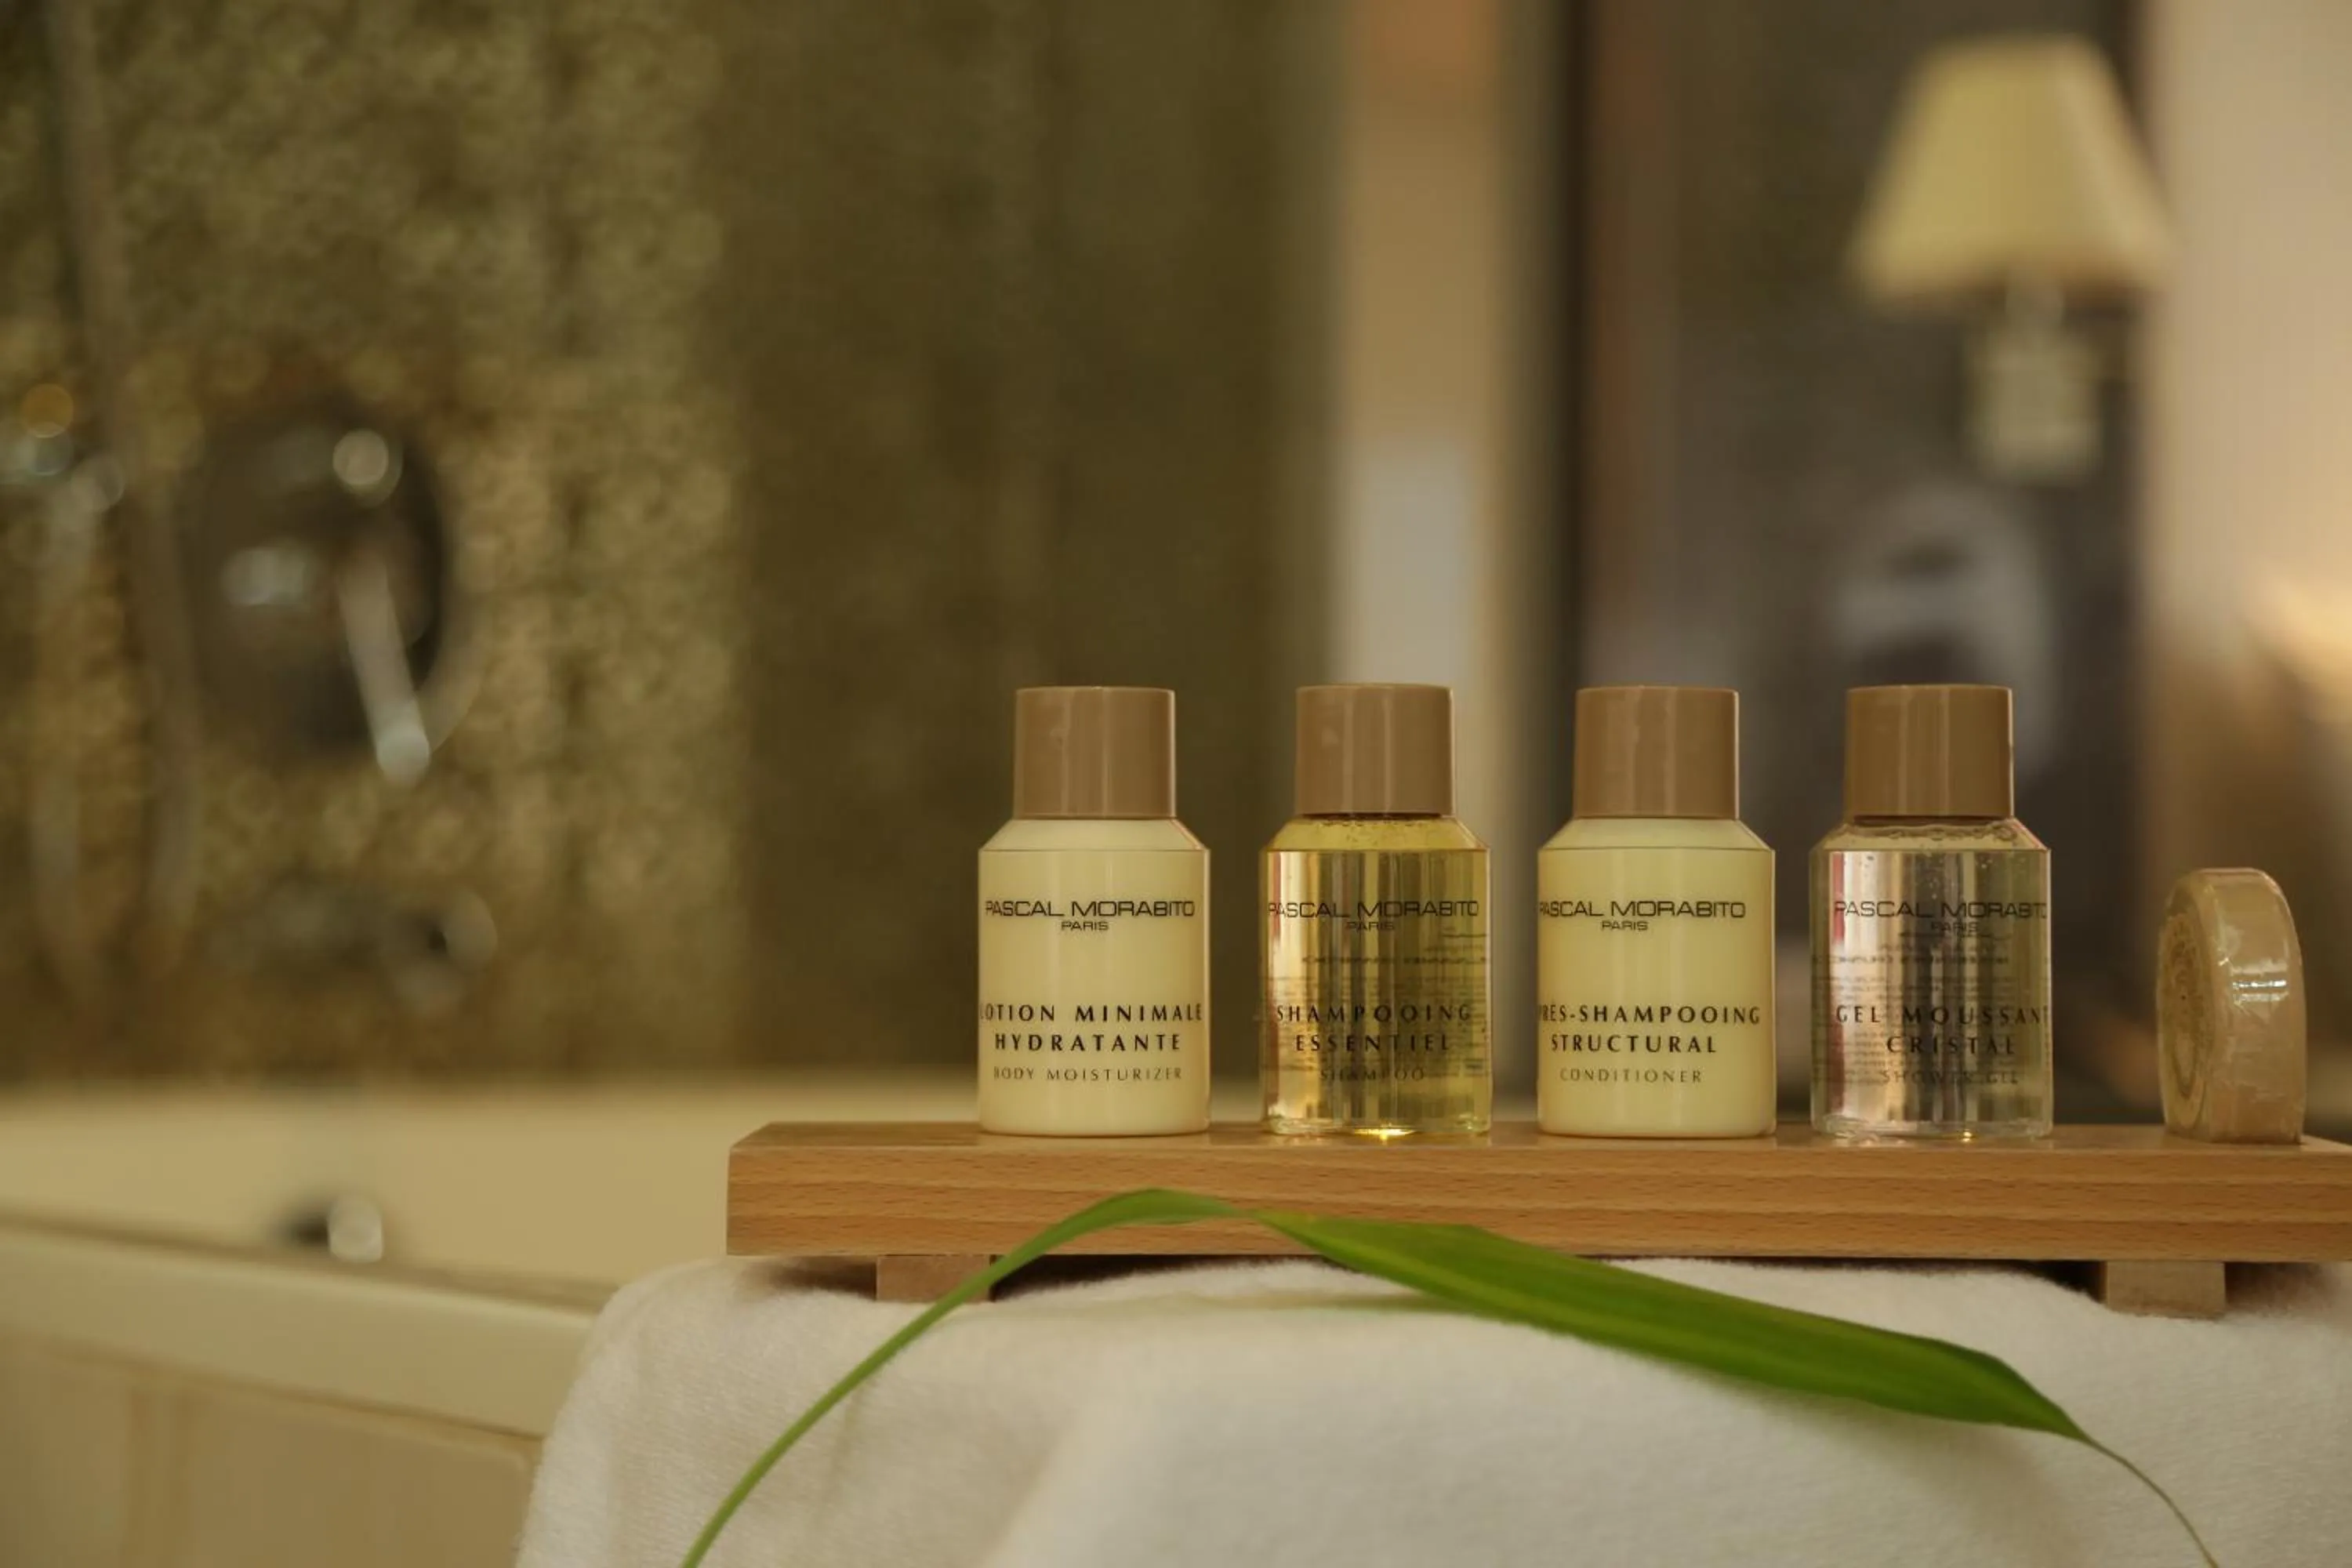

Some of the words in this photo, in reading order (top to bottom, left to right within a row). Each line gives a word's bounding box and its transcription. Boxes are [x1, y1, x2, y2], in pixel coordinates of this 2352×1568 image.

[985, 900, 1065, 916] PASCAL
[1071, 900, 1195, 916] MORABITO
[1268, 902, 1349, 918] PASCAL
[1357, 901, 1479, 917] MORABITO
[1611, 901, 1746, 918] MORABITO
[1835, 901, 1934, 918] PASCAL
[1061, 920, 1109, 931] PARIS
[1345, 921, 1396, 931] PARIS
[1602, 920, 1649, 931] PARIS
[1075, 1004, 1202, 1022] MINIMALE
[1277, 1004, 1472, 1022] SHAMPOOING
[1836, 1004, 1881, 1023] GEL
[994, 1033, 1181, 1051] HYDRATANTE
[1296, 1034, 1449, 1052] ESSENTIEL
[1551, 1034, 1717, 1053] STRUCTURAL
[1886, 1036, 2015, 1054] CRISTAL
[993, 1067, 1035, 1080] BODY
[1046, 1067, 1182, 1082] MOISTURIZER
[1559, 1067, 1703, 1083] CONDITIONER
